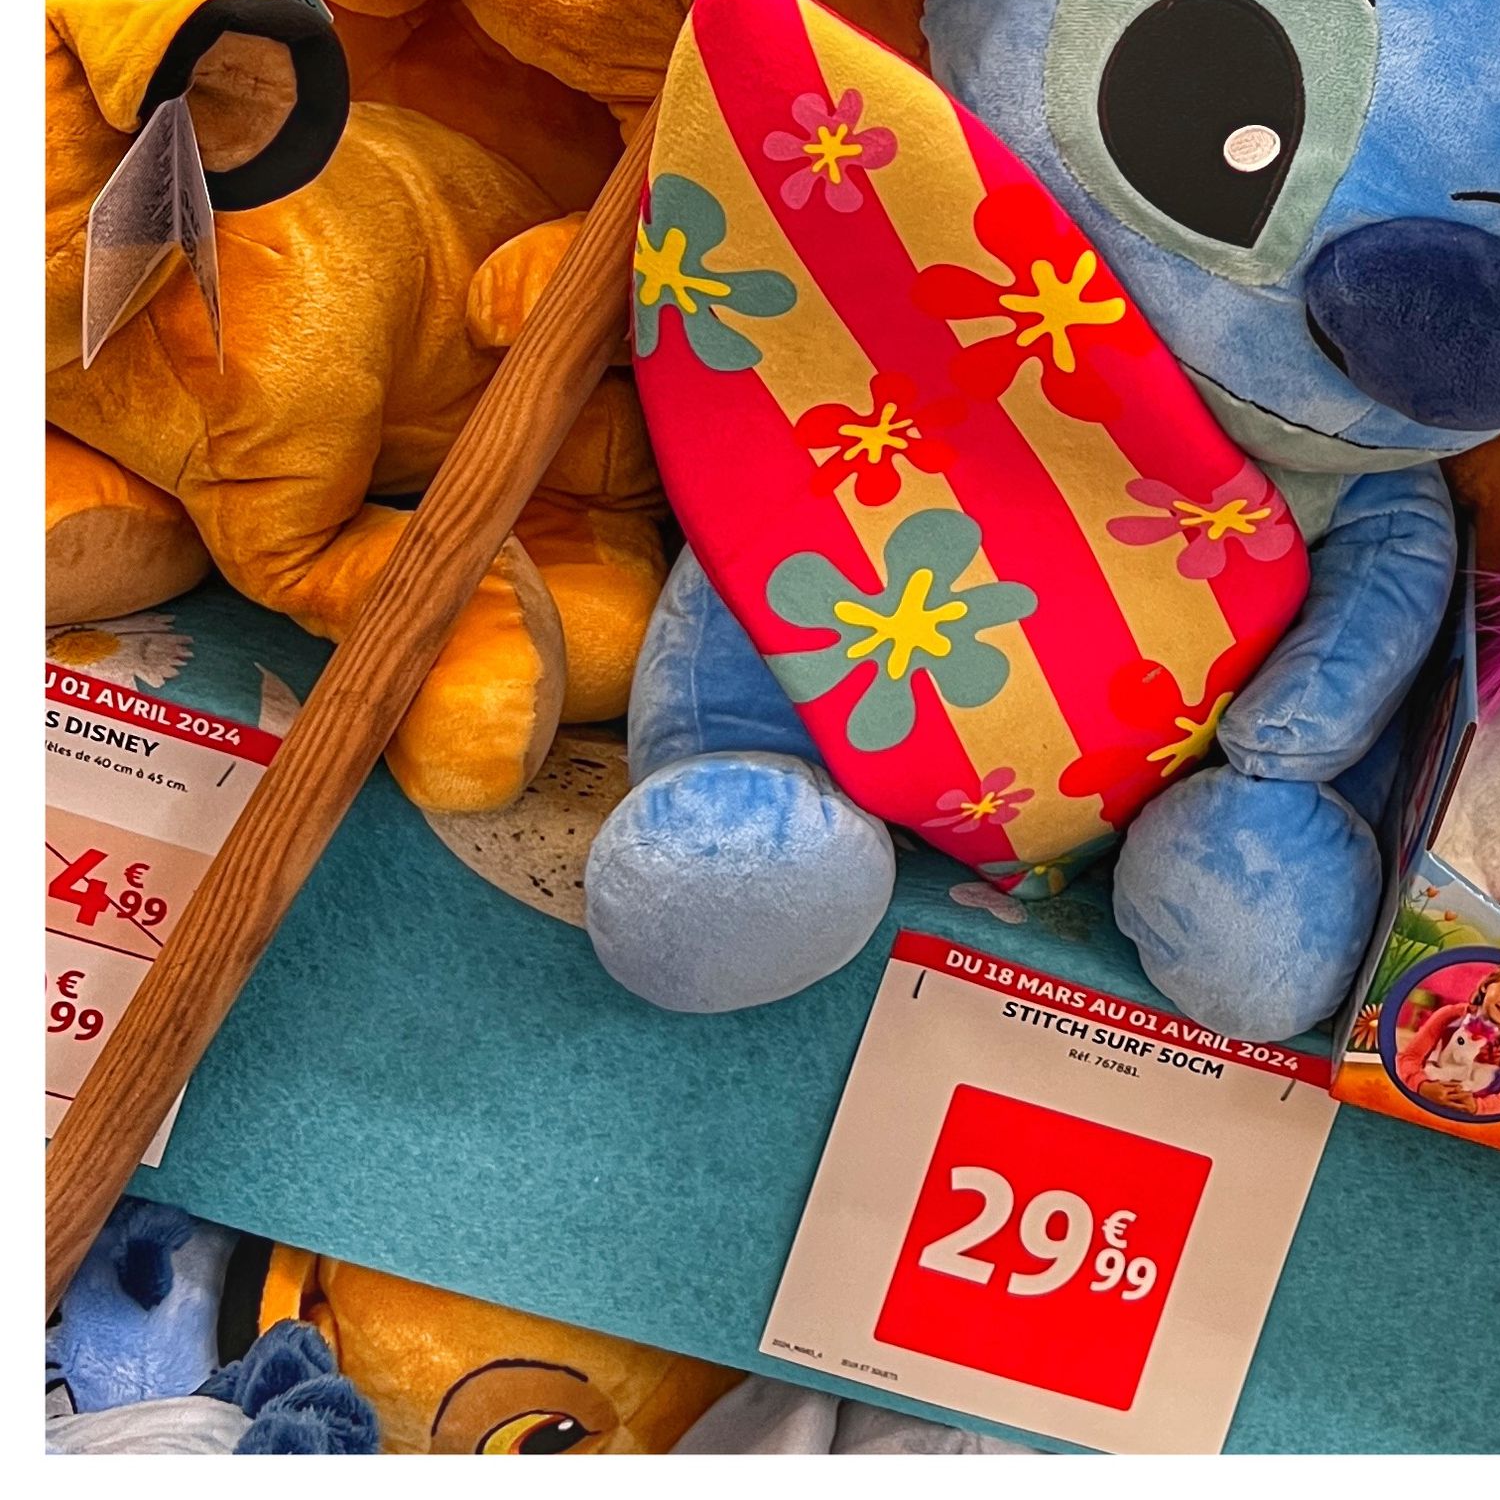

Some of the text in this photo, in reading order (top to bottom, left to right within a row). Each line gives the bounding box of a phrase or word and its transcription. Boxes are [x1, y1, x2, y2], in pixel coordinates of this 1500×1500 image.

[60, 676, 91, 701] 01
[95, 687, 172, 727] AVRIL
[175, 711, 242, 747] 2024
[64, 715, 160, 758] DISNEY
[75, 749, 92, 764] de
[93, 755, 112, 769] 40
[113, 763, 133, 776] cm
[136, 767, 145, 780] à
[148, 772, 165, 786] 45
[945, 948, 1301, 1072] DU 18 MARS AU 01 AVRIL 2024
[1002, 1000, 1226, 1080] STITCH SURF 50CM
[1068, 1047, 1092, 1065] Réf.
[917, 1165, 1095, 1296] 29
